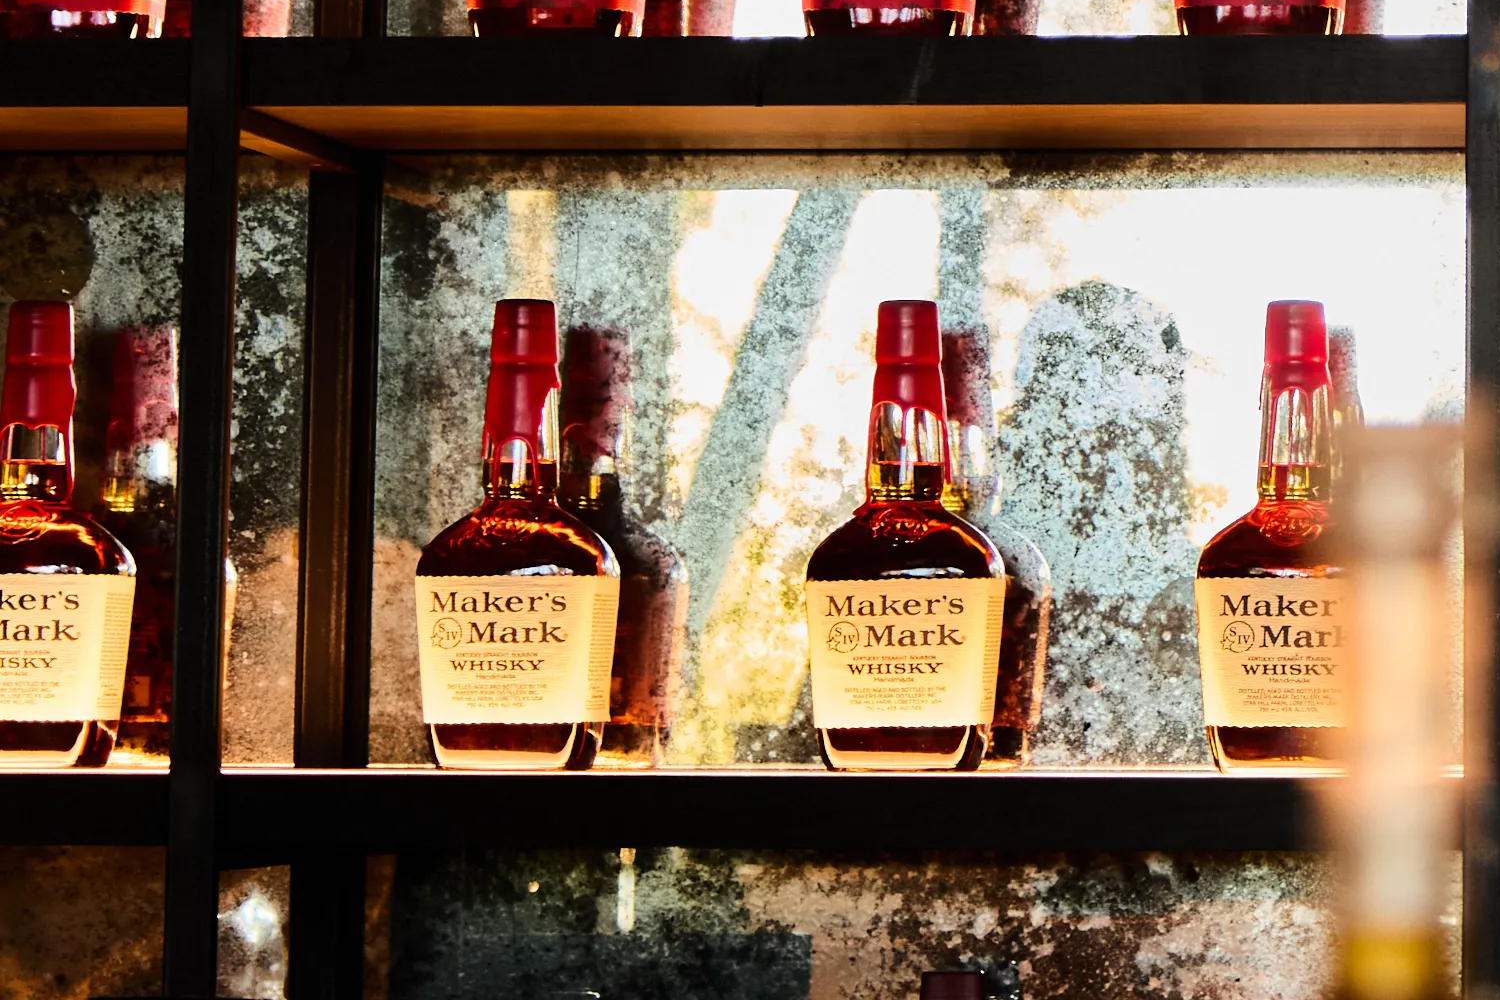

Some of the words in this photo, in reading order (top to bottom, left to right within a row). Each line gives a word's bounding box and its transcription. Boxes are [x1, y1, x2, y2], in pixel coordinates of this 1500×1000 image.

[0, 589, 80, 610] ker's
[430, 591, 567, 613] Maker's
[825, 594, 964, 617] Maker's
[466, 621, 567, 644] Mark
[863, 624, 964, 648] Mark
[0, 658, 57, 668] ISKY
[449, 660, 545, 671] WHISKY
[847, 663, 944, 675] WHISKY
[1241, 664, 1339, 676] WHISKY
